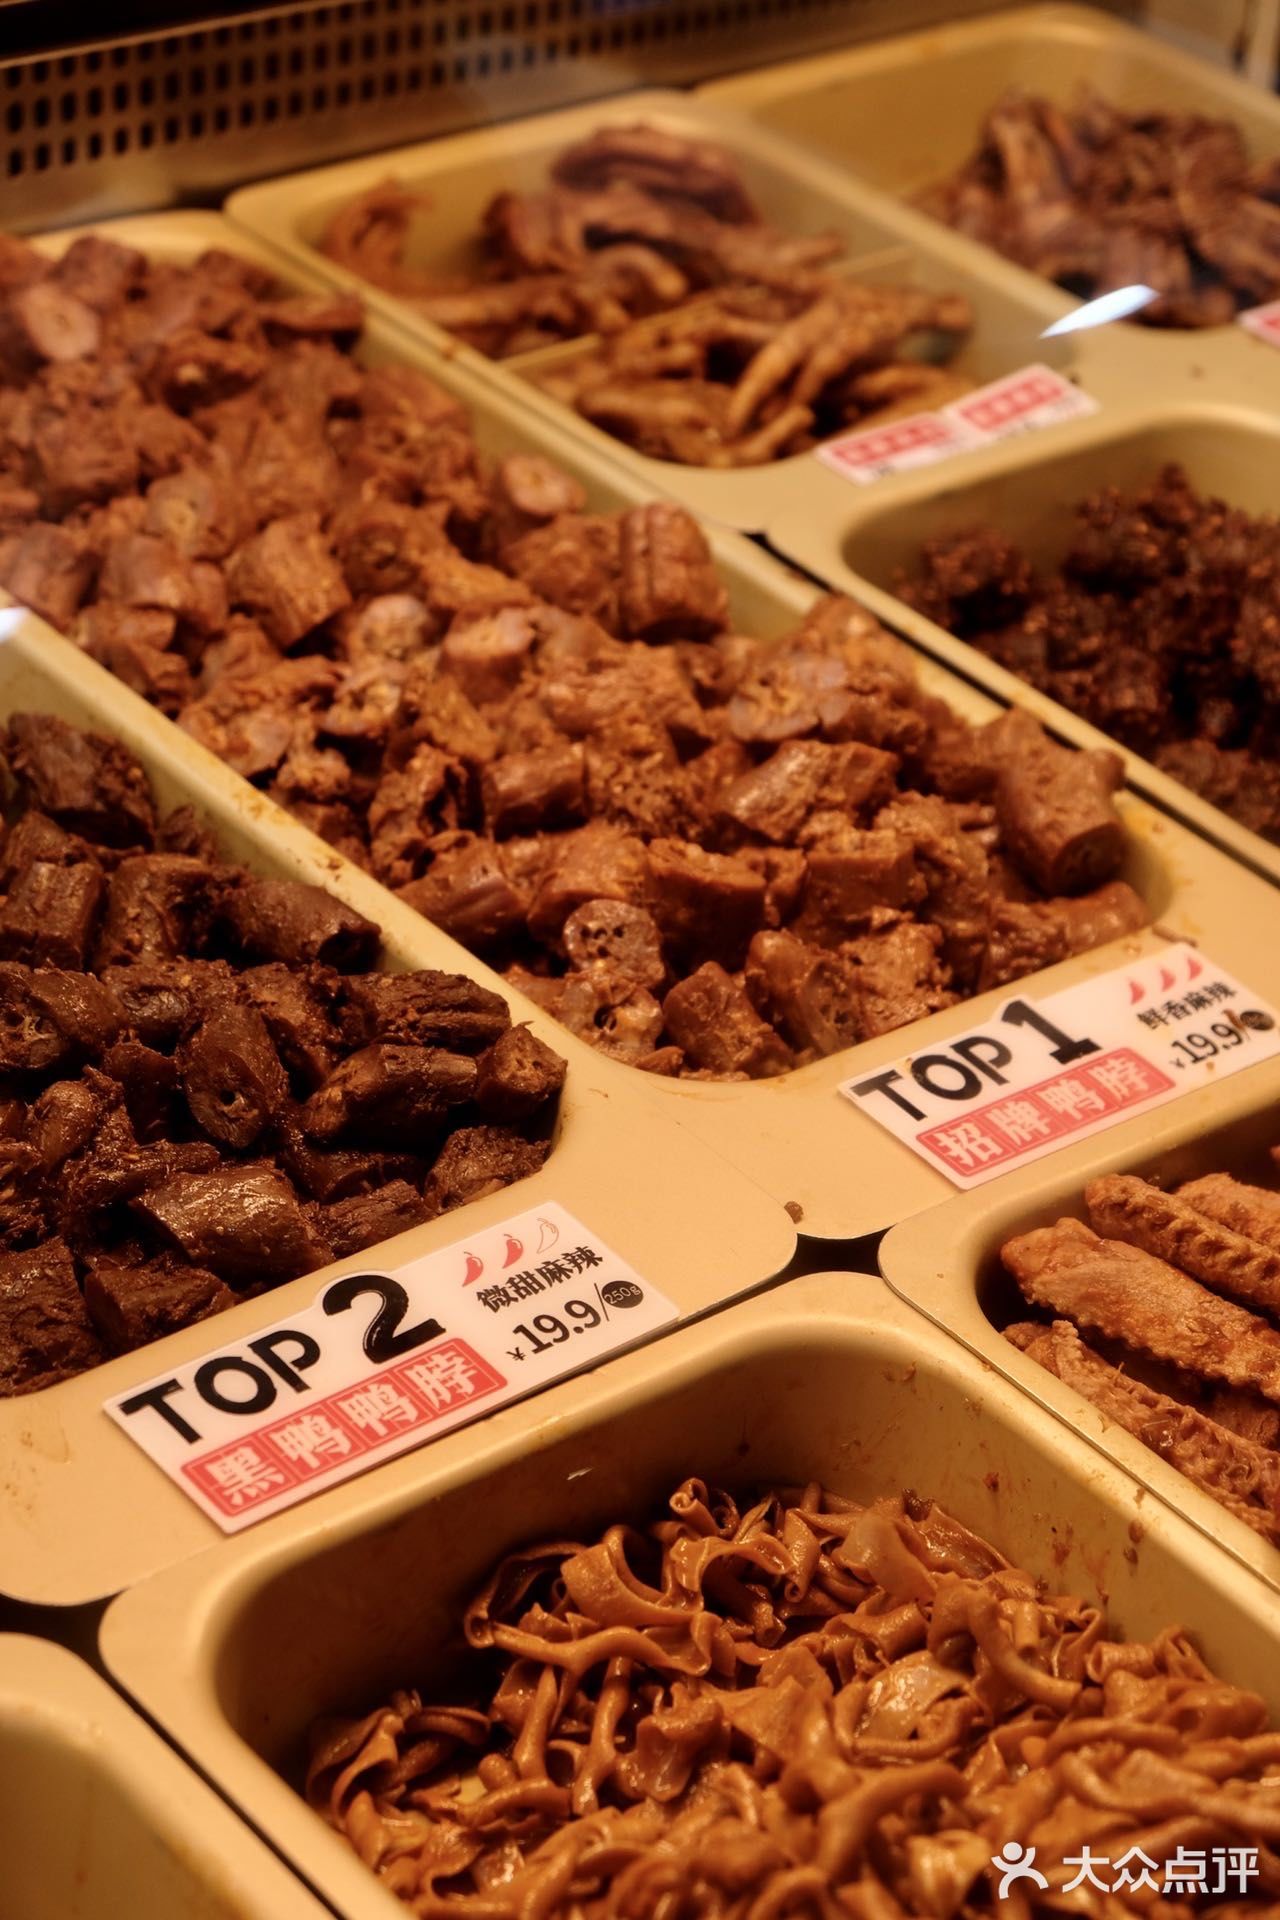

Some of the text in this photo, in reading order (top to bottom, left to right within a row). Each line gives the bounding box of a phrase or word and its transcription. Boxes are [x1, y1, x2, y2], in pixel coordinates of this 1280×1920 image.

[850, 999, 1102, 1121] TOP 1
[1136, 981, 1237, 1031] 鲜香麻辣
[935, 1057, 1150, 1167] 招牌鸭脖
[476, 1245, 603, 1313] 微甜麻辣
[119, 1273, 447, 1445] TOP 2
[206, 1348, 479, 1507] 黑鸭鸭脖
